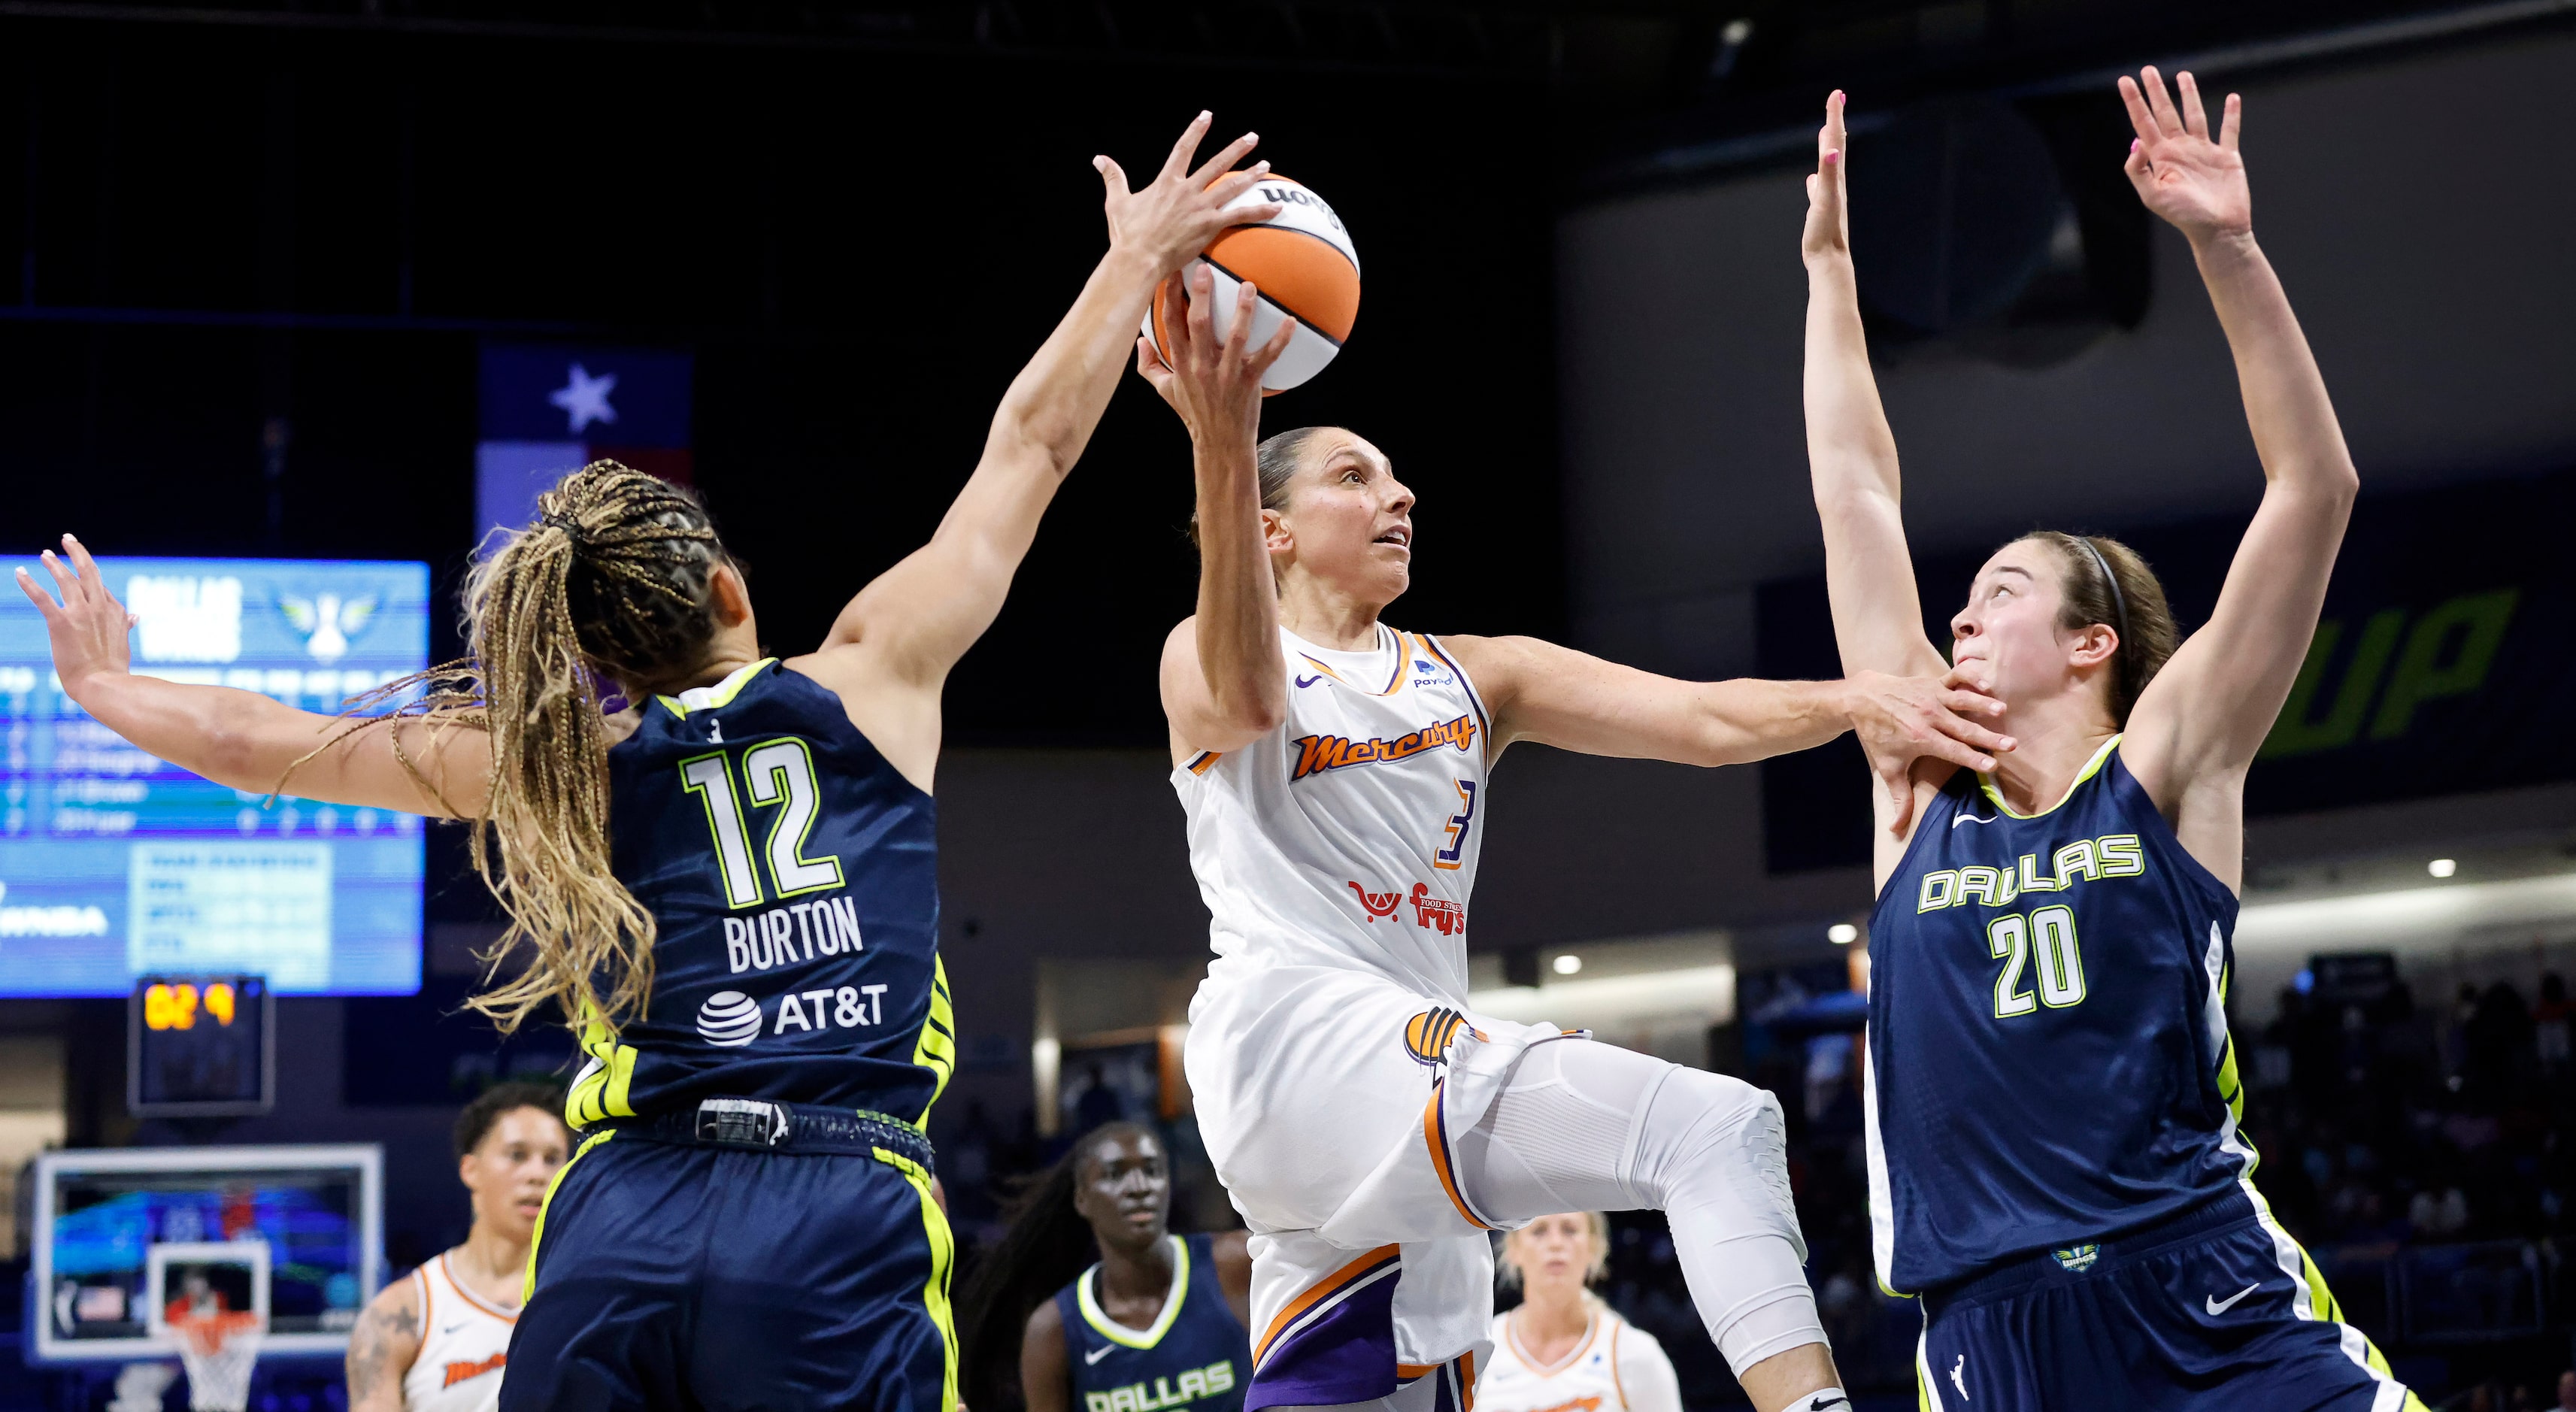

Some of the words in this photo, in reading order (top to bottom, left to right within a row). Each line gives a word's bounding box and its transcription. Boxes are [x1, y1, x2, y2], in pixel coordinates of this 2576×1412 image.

[1291, 714, 1476, 782] Mercury
[678, 736, 846, 910] 12
[1433, 776, 1476, 870] 3
[1420, 898, 1442, 908] FOOD
[1917, 834, 2145, 914] DALLAS
[723, 895, 864, 974] BURTON
[1987, 904, 2087, 1019] 20
[774, 983, 889, 1036] AT&T
[1085, 1359, 1235, 1412] DALLAS
